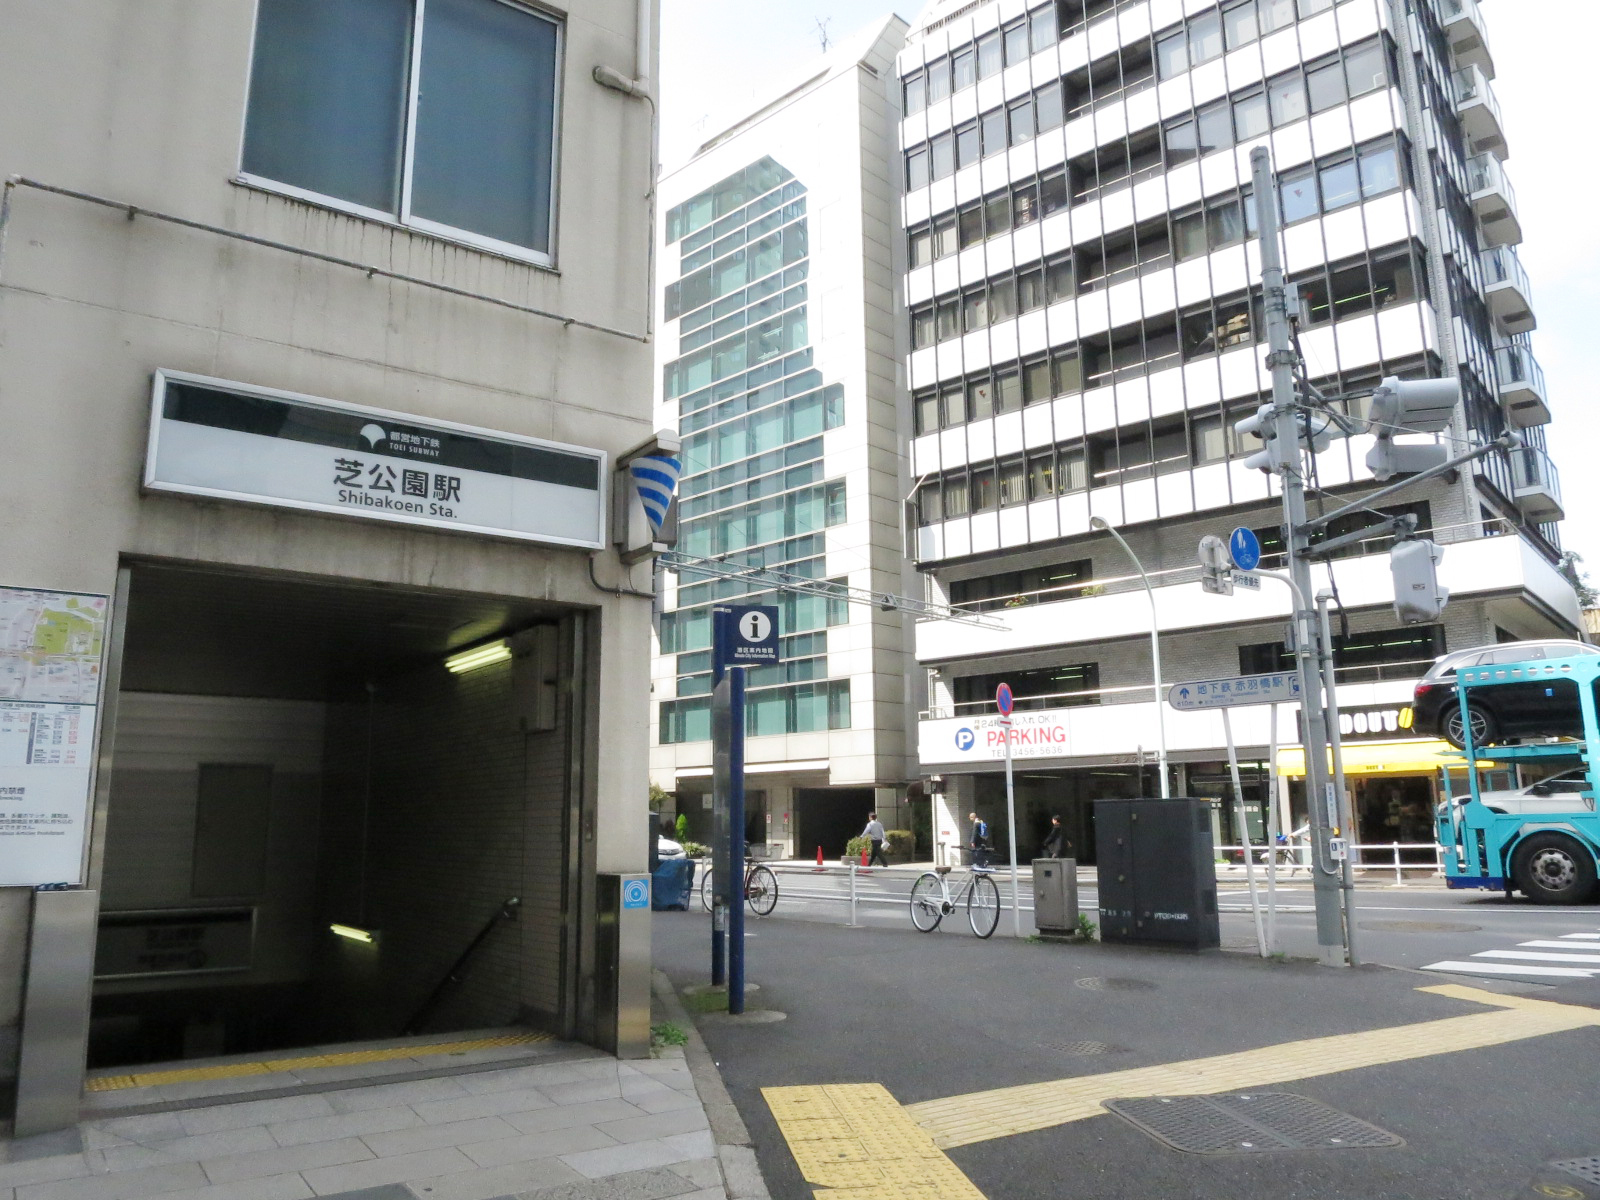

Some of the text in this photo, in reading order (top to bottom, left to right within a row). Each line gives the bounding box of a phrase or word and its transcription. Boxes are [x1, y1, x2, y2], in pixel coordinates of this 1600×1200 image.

[390, 432, 440, 448] 都営地下鉄
[390, 442, 440, 457] TOEI SUBWAY
[333, 457, 461, 503] 芝公園駅
[338, 489, 458, 519] Shibakoen Sta.
[1197, 682, 1231, 695] 地下鉄
[1235, 676, 1284, 691] 赤羽橋駅
[1339, 708, 1414, 734] DOUTO
[987, 726, 1066, 747] PARKING
